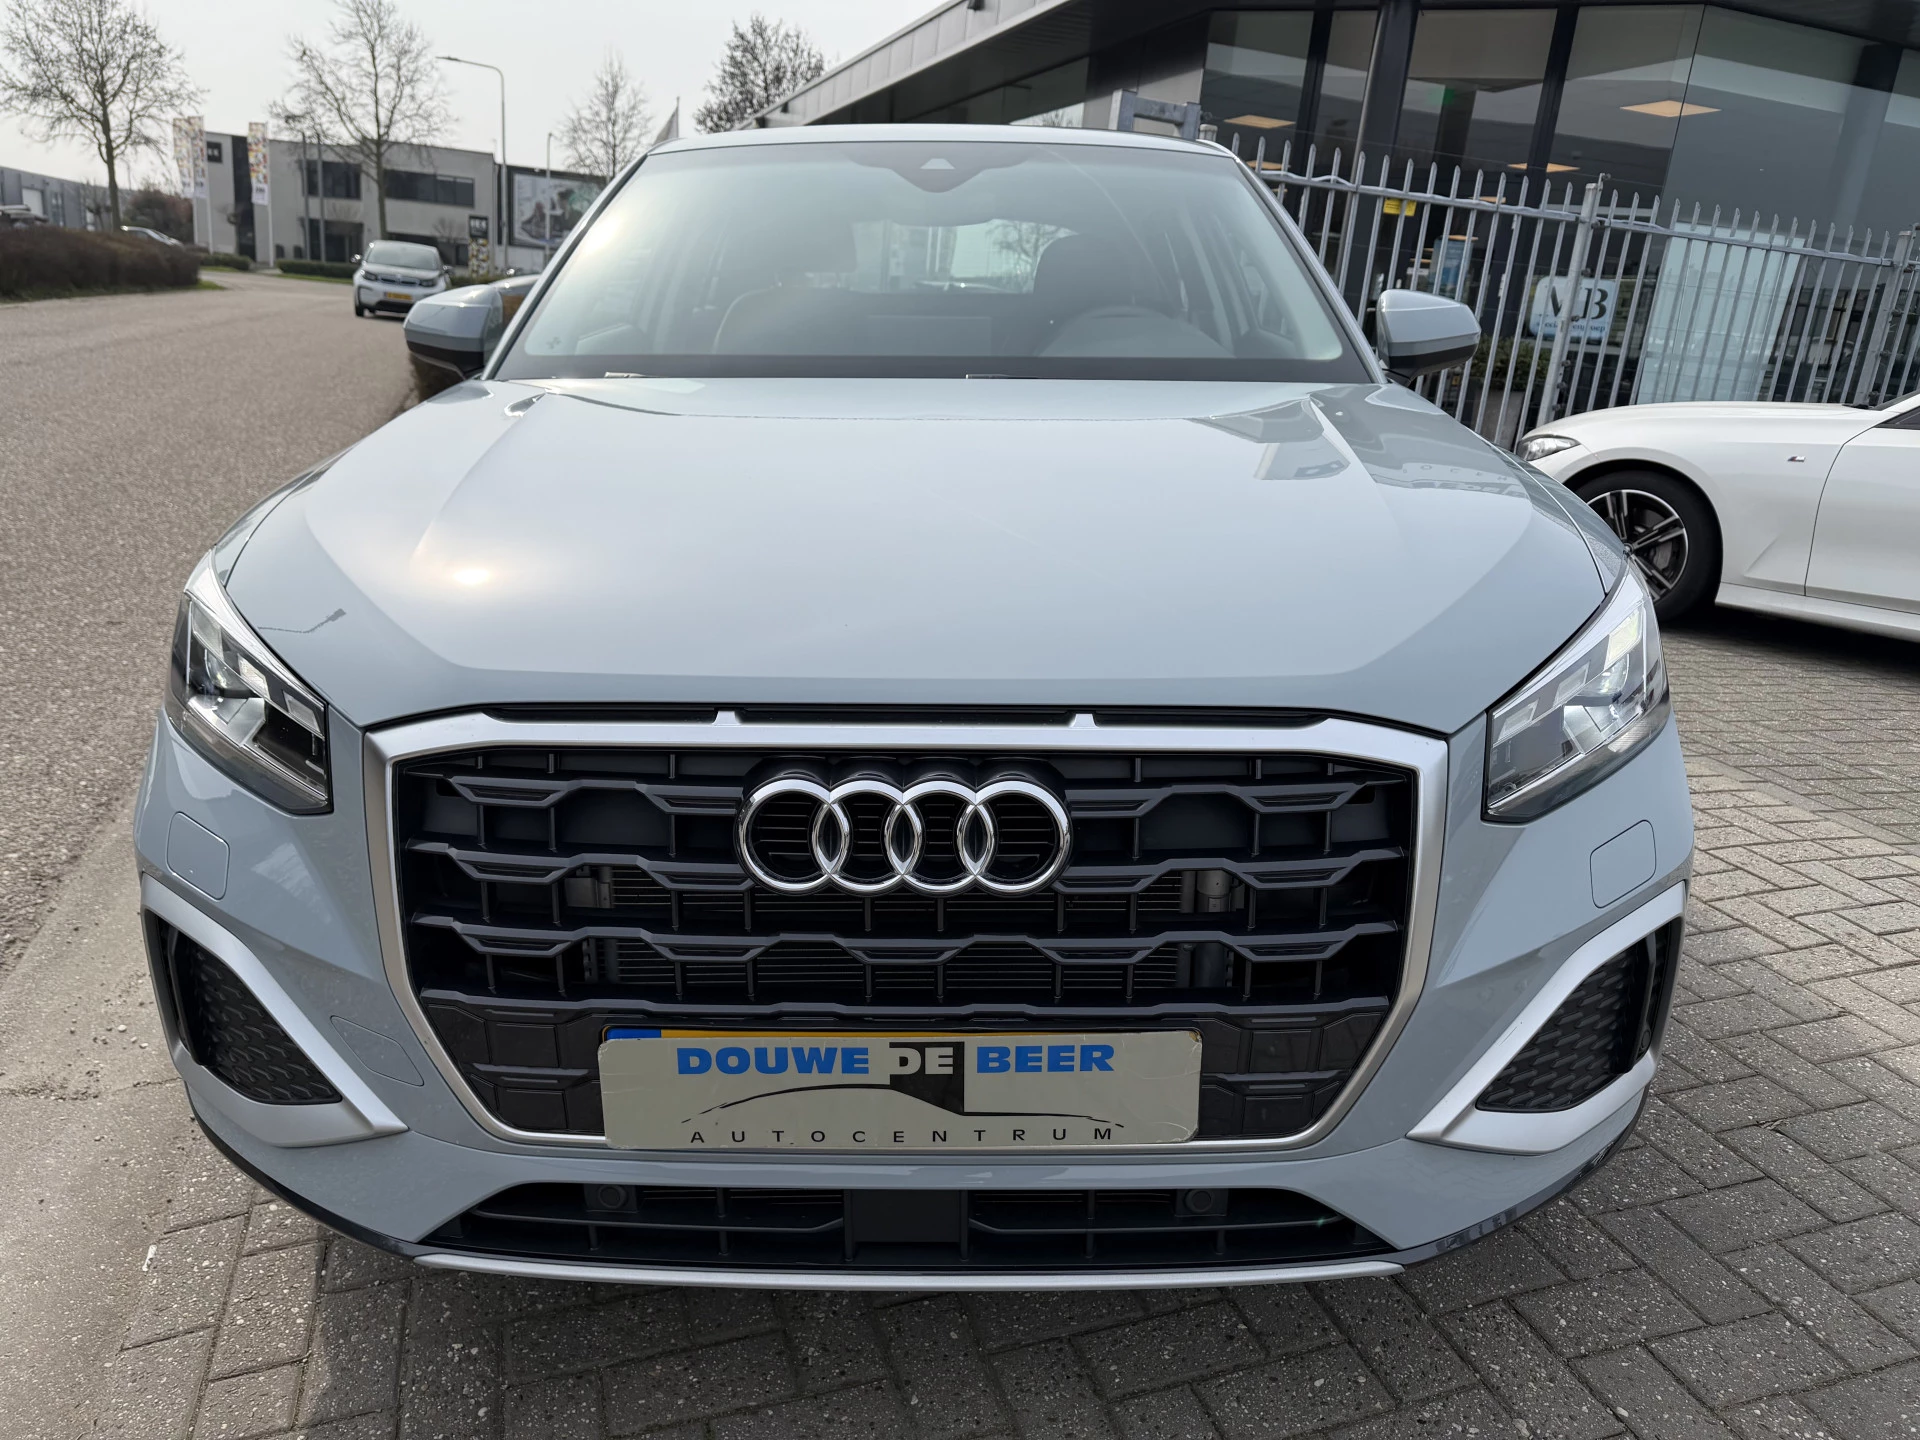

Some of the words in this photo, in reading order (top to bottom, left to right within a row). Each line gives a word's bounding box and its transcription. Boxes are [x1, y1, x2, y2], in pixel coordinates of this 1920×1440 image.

[677, 1047, 869, 1075] DOUWE
[890, 1048, 955, 1075] DE
[976, 1044, 1115, 1073] BEER
[690, 1128, 1112, 1144] AUTOCENTRUM
